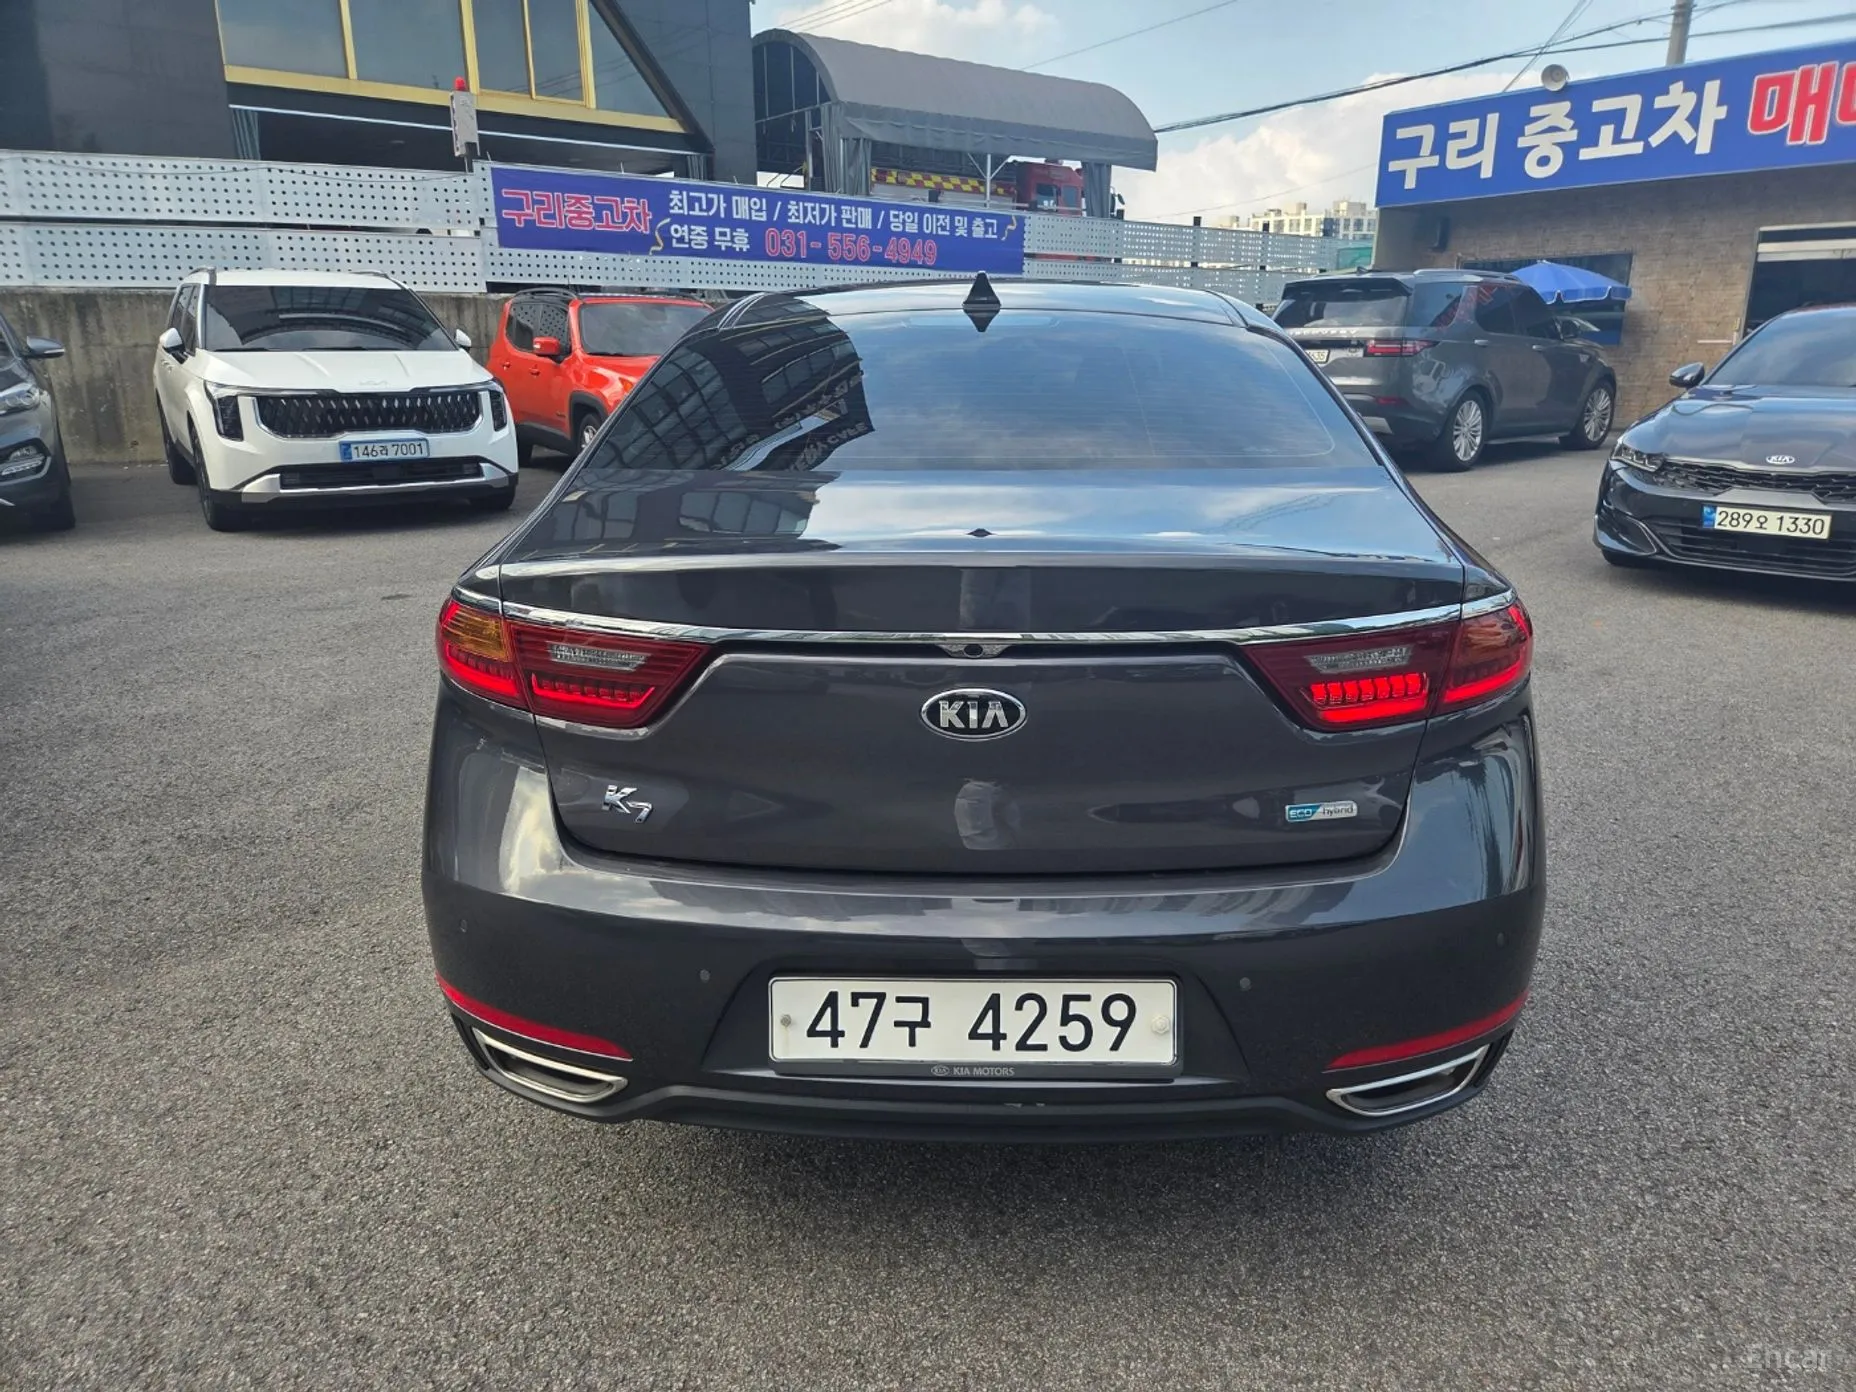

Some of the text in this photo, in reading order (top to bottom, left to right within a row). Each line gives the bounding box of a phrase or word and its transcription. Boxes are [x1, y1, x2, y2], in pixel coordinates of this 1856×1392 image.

[1388, 60, 1856, 189] 구리 중고차 매
[502, 189, 652, 233] 구리중고차
[669, 190, 998, 239] 최고가 매입 / 최저가 판매 / 당일 이전 및 출고
[670, 224, 708, 250] 연중
[714, 227, 750, 252] 무휴
[391, 443, 424, 456] 7001
[1717, 511, 1825, 535] 289오 1330
[938, 700, 1009, 729] KIA
[602, 784, 652, 823] K7
[1322, 803, 1354, 816] hybrid
[806, 991, 1138, 1052] 47구 4259
[953, 1067, 970, 1076] KIA
[973, 1067, 1015, 1076] MOTORS
